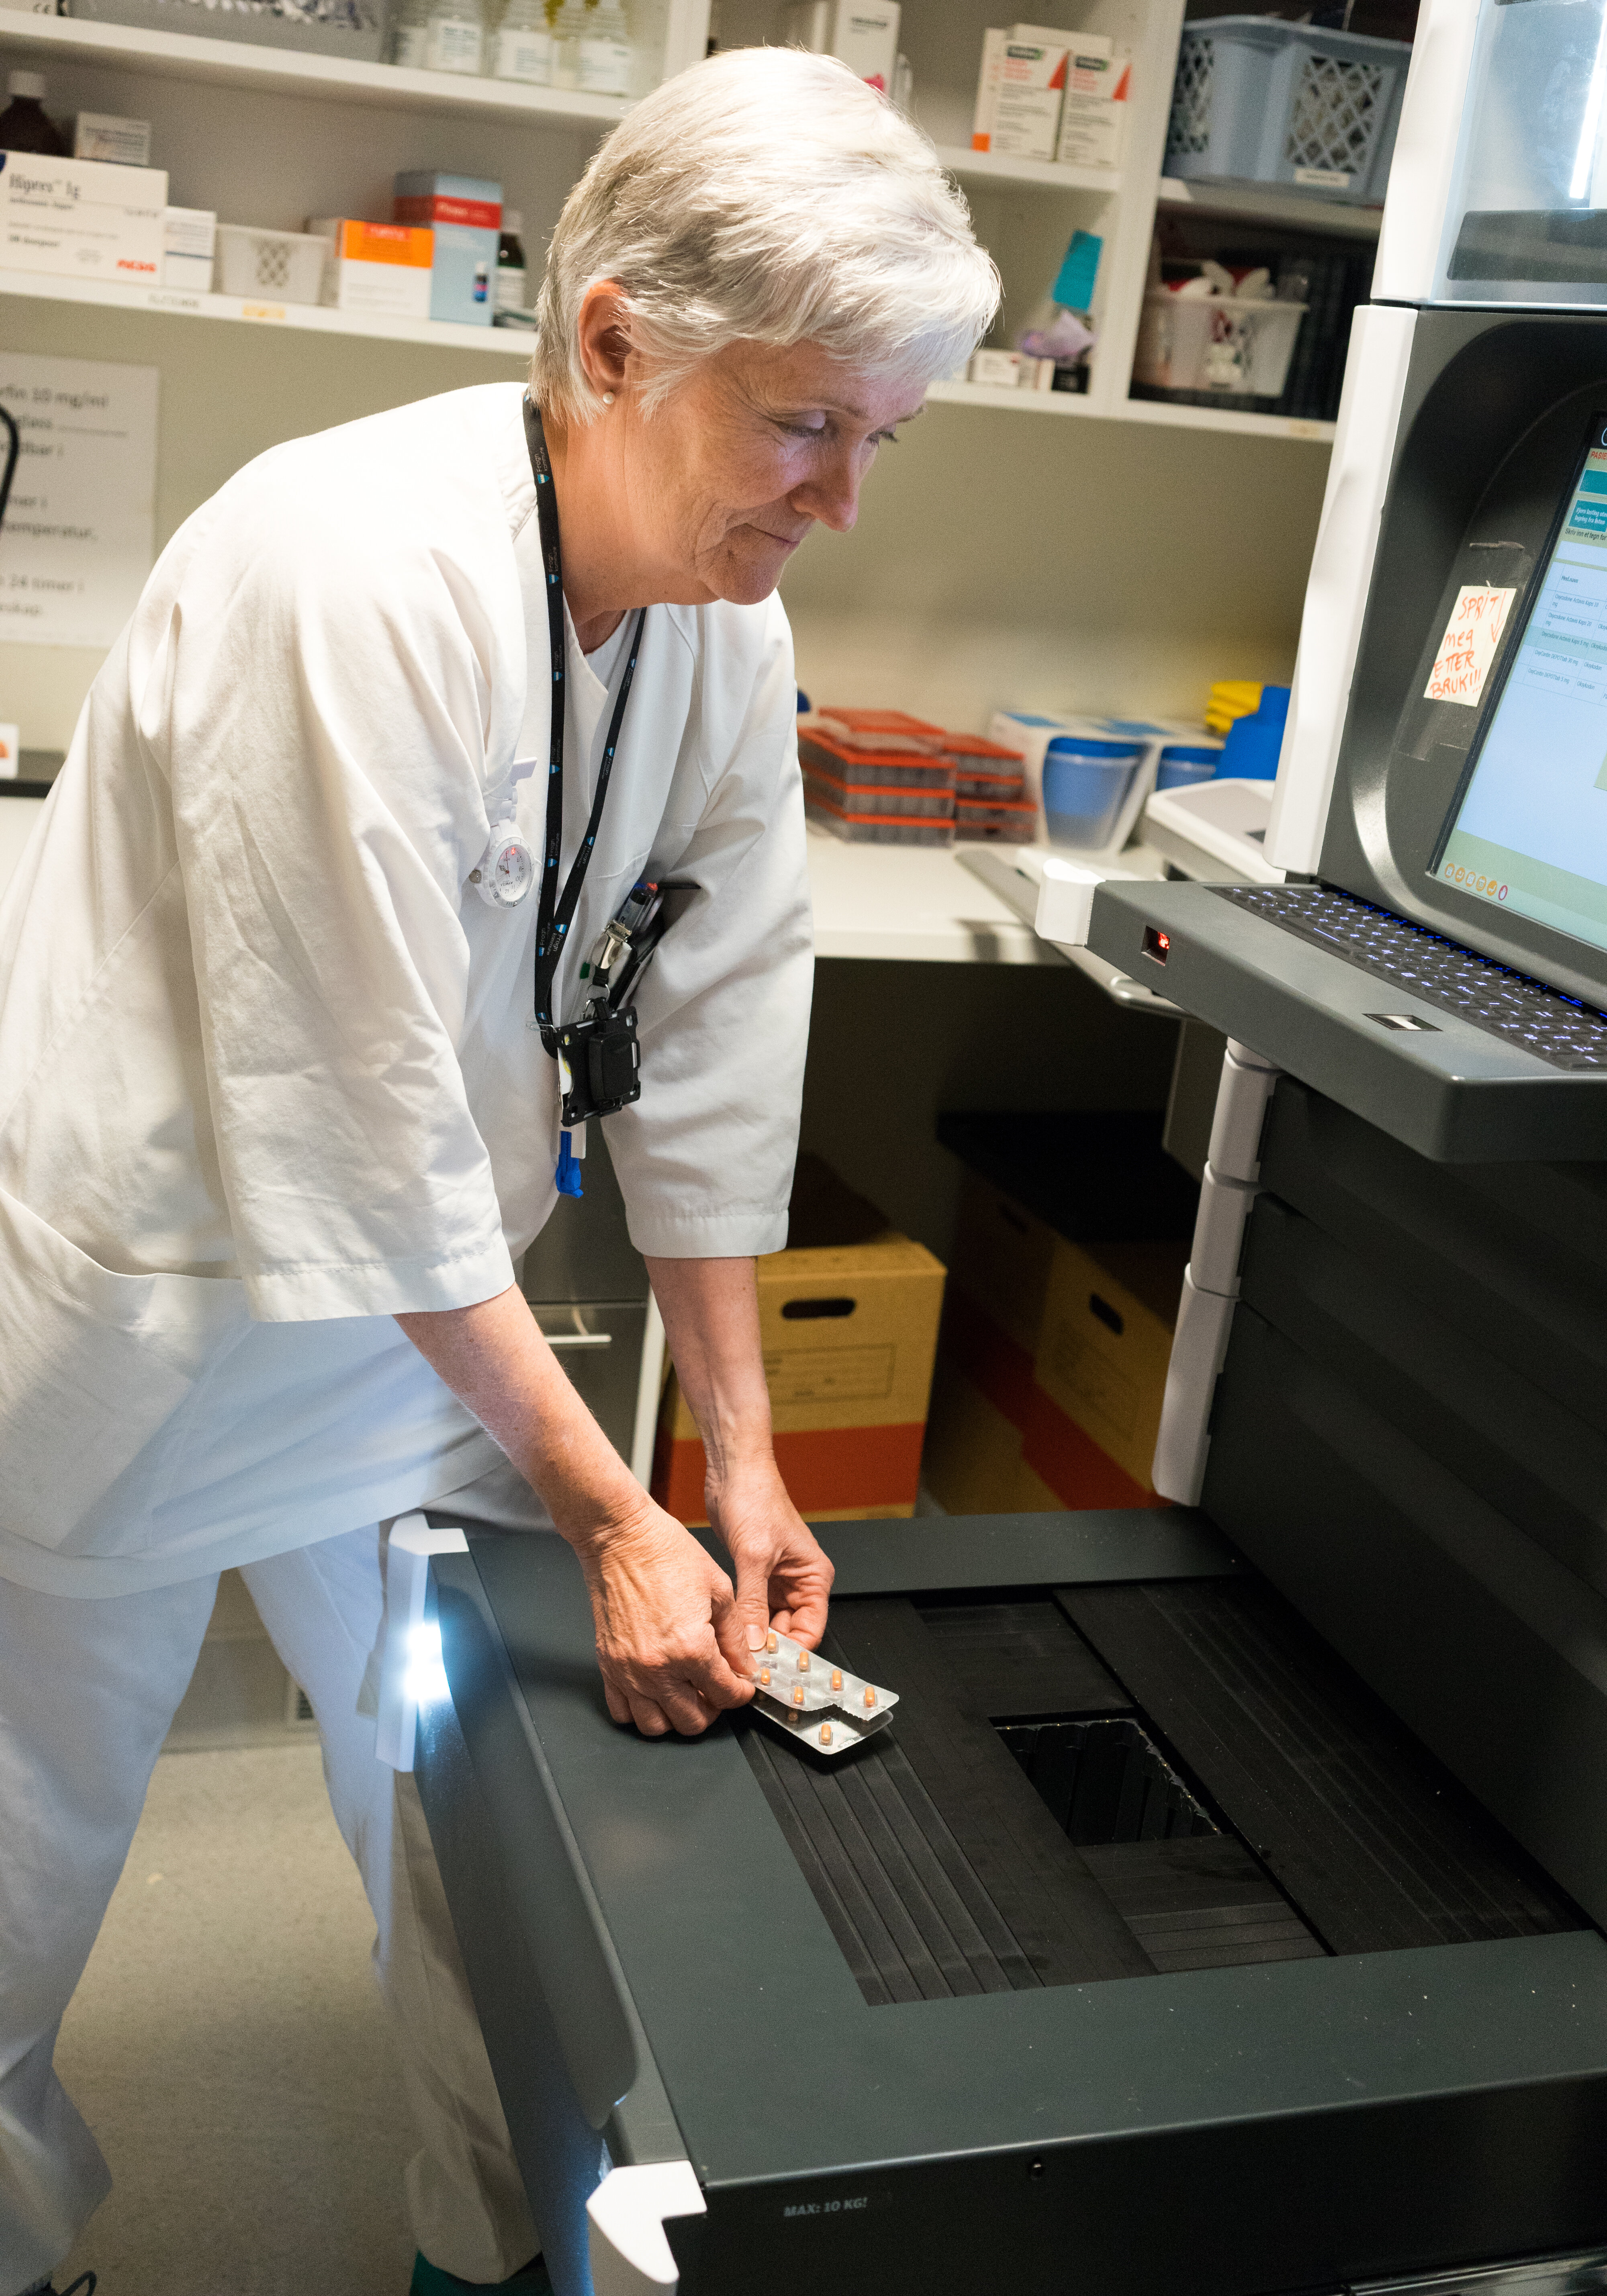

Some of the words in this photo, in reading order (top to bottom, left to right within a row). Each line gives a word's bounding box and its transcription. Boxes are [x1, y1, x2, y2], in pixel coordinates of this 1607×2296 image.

[1555, 594, 1573, 602] Oxycodone
[1548, 612, 1566, 621] Oxycodone
[1542, 631, 1559, 640] Oxycodone
[1535, 649, 1551, 658] OxyContin
[1551, 653, 1567, 662] DEPOTtab
[1433, 650, 1475, 679] ETTER
[1584, 662, 1602, 671] Oksykodon
[1528, 668, 1544, 677] OxyContin
[1544, 672, 1560, 681] DEPOTtab
[1430, 668, 1482, 699] BRUK!!!
[1577, 681, 1595, 690] Oksykodon
[547, 932, 557, 956] kommune
[553, 934, 563, 952] Frogn
[784, 2204, 820, 2217] MAX:
[824, 2200, 841, 2212] 10
[844, 2196, 868, 2210] KG!
